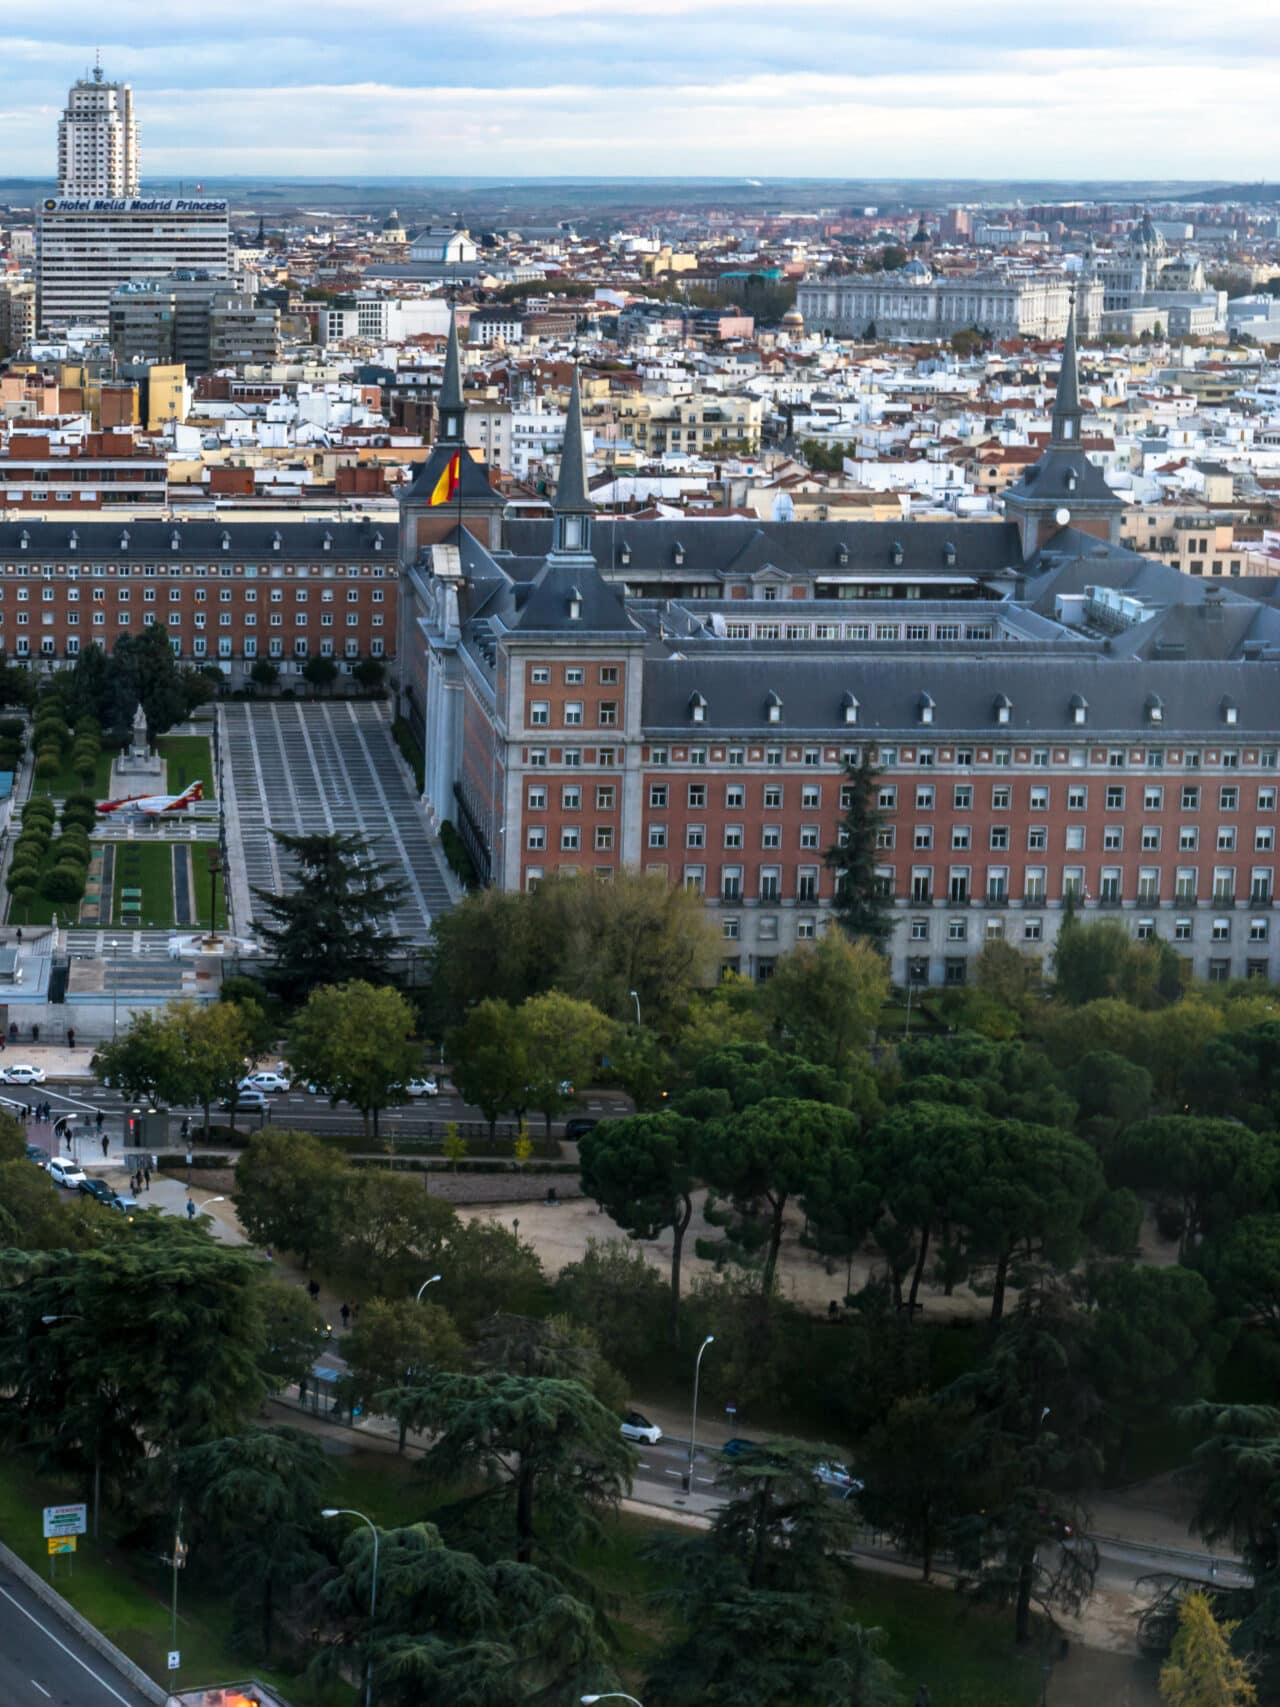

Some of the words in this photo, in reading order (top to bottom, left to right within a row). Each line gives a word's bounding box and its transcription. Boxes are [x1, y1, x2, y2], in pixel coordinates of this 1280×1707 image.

[59, 200, 89, 210] Hotel
[130, 200, 170, 210] Madrid
[175, 200, 226, 210] Princesa
